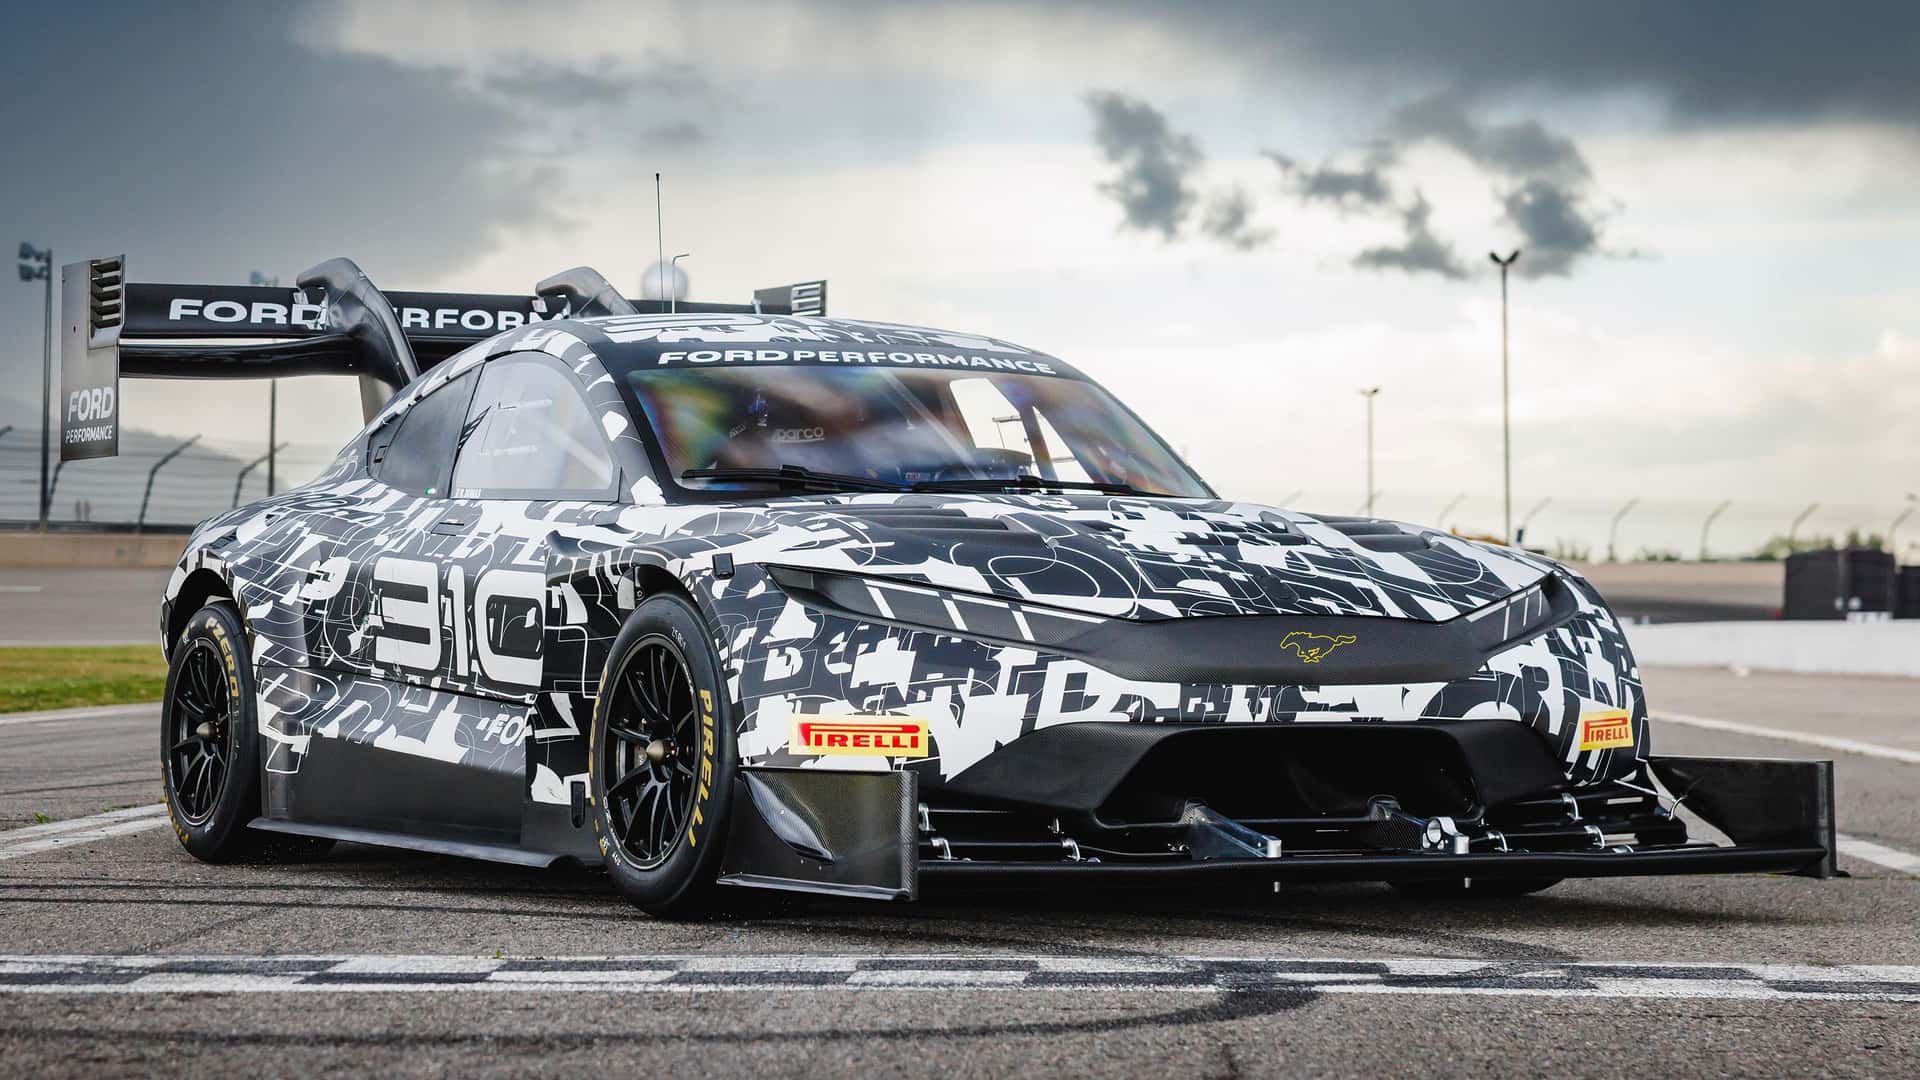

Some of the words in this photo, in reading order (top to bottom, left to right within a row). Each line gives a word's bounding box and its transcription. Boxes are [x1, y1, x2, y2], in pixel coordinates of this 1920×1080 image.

[168, 297, 327, 328] FORD
[658, 349, 790, 365] FORD
[794, 349, 1055, 375] PERFORMANCE
[67, 386, 114, 423] FORD
[64, 424, 113, 444] PERFORMANCE
[799, 722, 921, 749] PIRELLI
[1583, 717, 1629, 743] PIRELLI
[688, 688, 714, 848] PIRELLI
